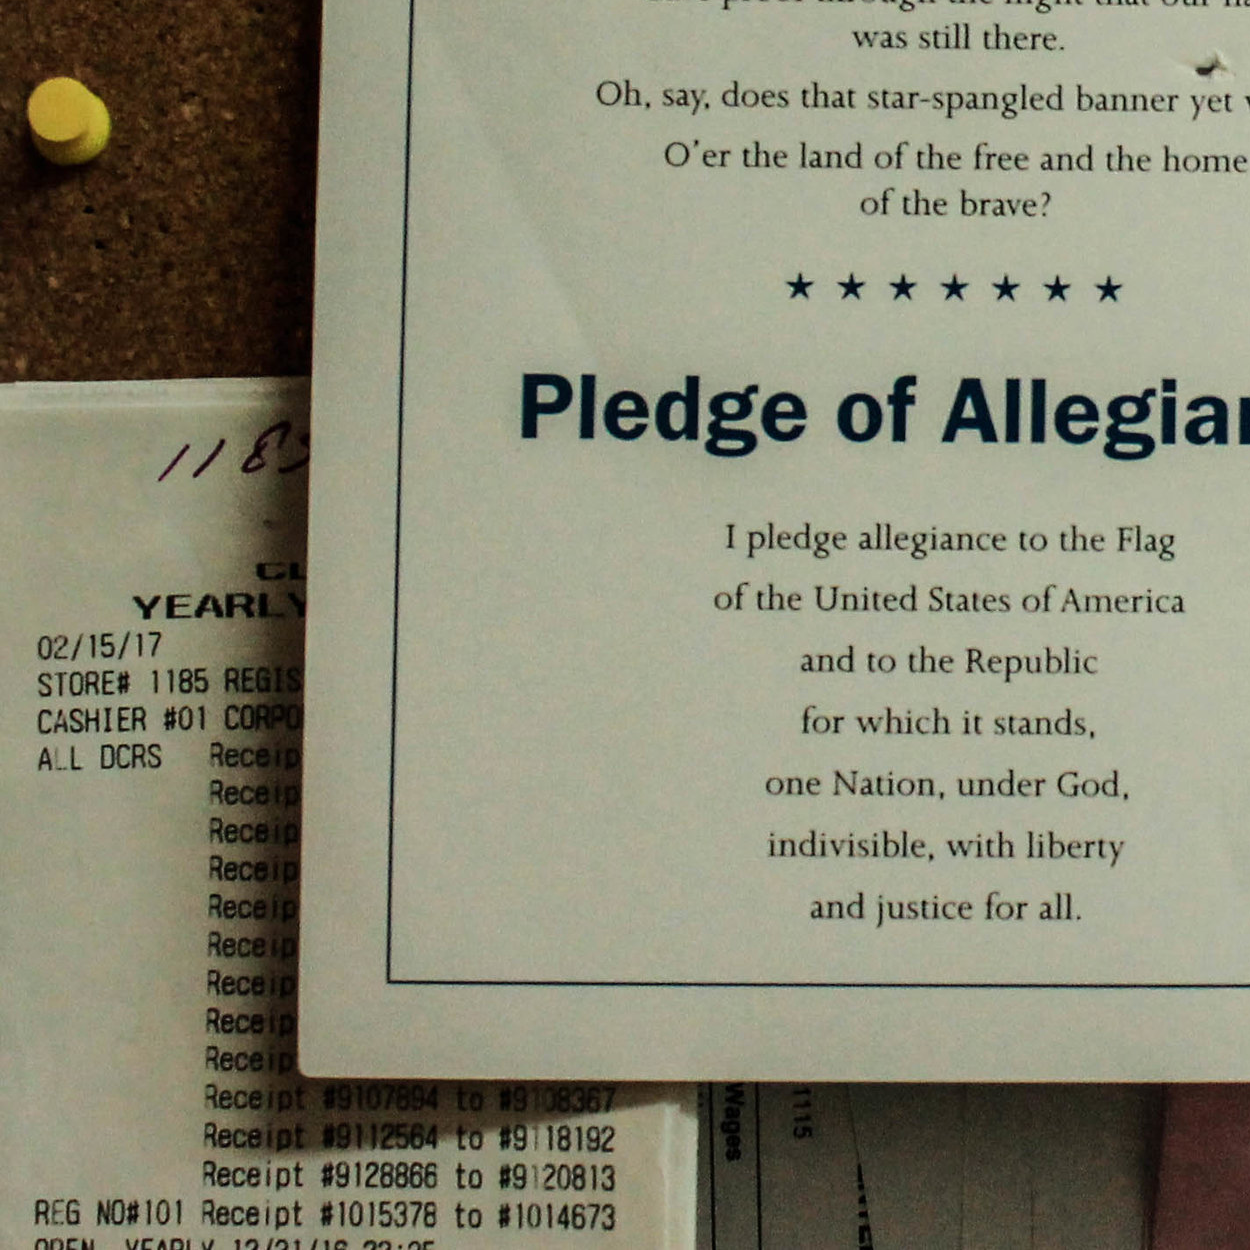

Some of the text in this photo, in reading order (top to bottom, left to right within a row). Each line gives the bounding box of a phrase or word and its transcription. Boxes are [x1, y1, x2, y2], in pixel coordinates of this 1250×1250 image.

[521, 372, 808, 458] Pledge
[837, 374, 918, 444] of
[726, 521, 1175, 562] I pledge allegiance to the Flag
[38, 632, 162, 661] 02/15/17
[38, 670, 130, 698] STORE#
[152, 668, 209, 694] 1185
[38, 707, 147, 735] CASHIER
[164, 706, 206, 731] #01
[101, 743, 162, 769] DCRS
[769, 829, 1125, 868] indivisible, with liberty
[810, 890, 1082, 929] and justice for all.
[203, 1123, 304, 1152] Receipt
[324, 1123, 439, 1150] #9112564
[457, 1127, 484, 1150] to
[720, 1083, 745, 1162] Wages
[34, 1199, 81, 1225] REG
[201, 1200, 303, 1231] Receipt
[321, 1201, 438, 1228] #1015378
[455, 1204, 484, 1229] to
[500, 1203, 617, 1231] #1014673
